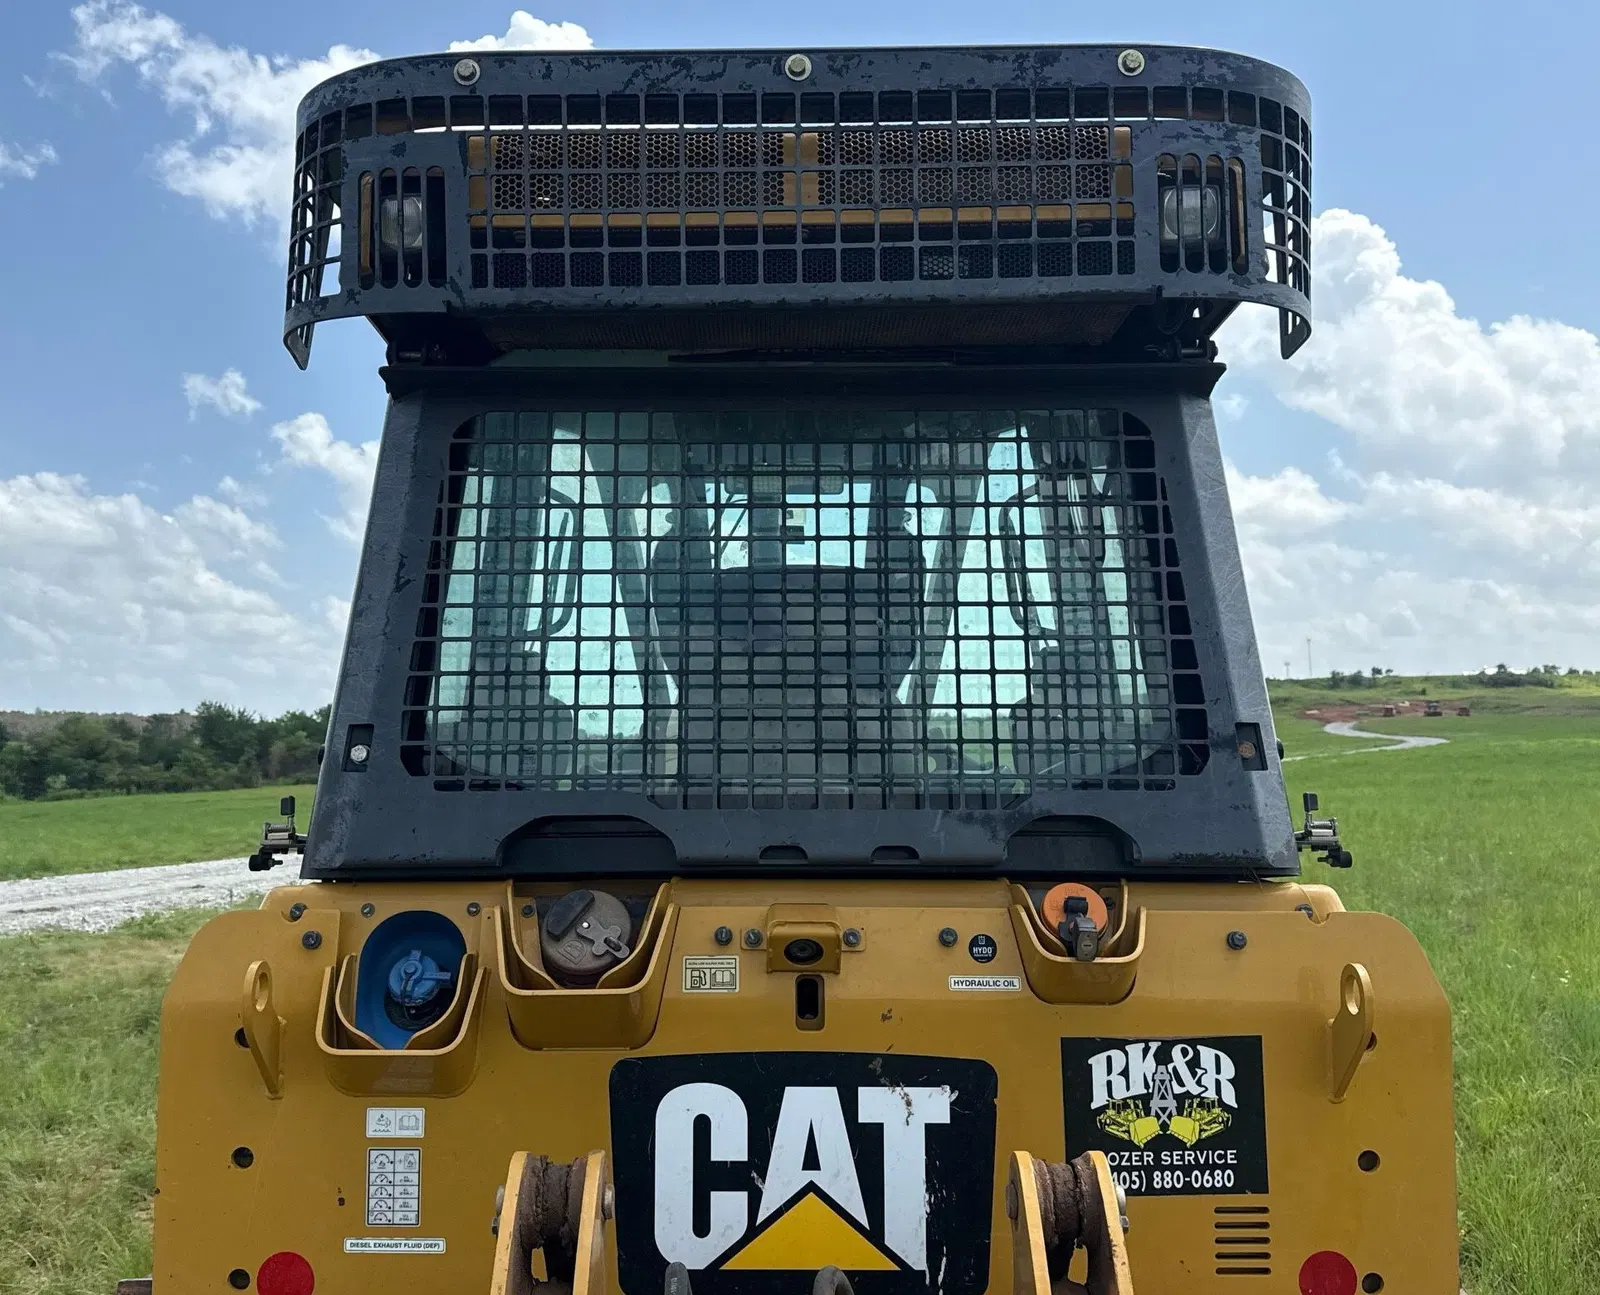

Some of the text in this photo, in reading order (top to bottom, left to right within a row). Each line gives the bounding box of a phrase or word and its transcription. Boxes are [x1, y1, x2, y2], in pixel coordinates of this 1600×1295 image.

[953, 979, 1017, 988] HYDRAULIC OIL
[1088, 1041, 1238, 1109] RK&R
[1106, 1149, 1238, 1167] OZER SERVICE
[654, 1082, 952, 1271] CAT
[1111, 1169, 1235, 1193] 405) 880-0680
[423, 1242, 440, 1250] (DEF)
